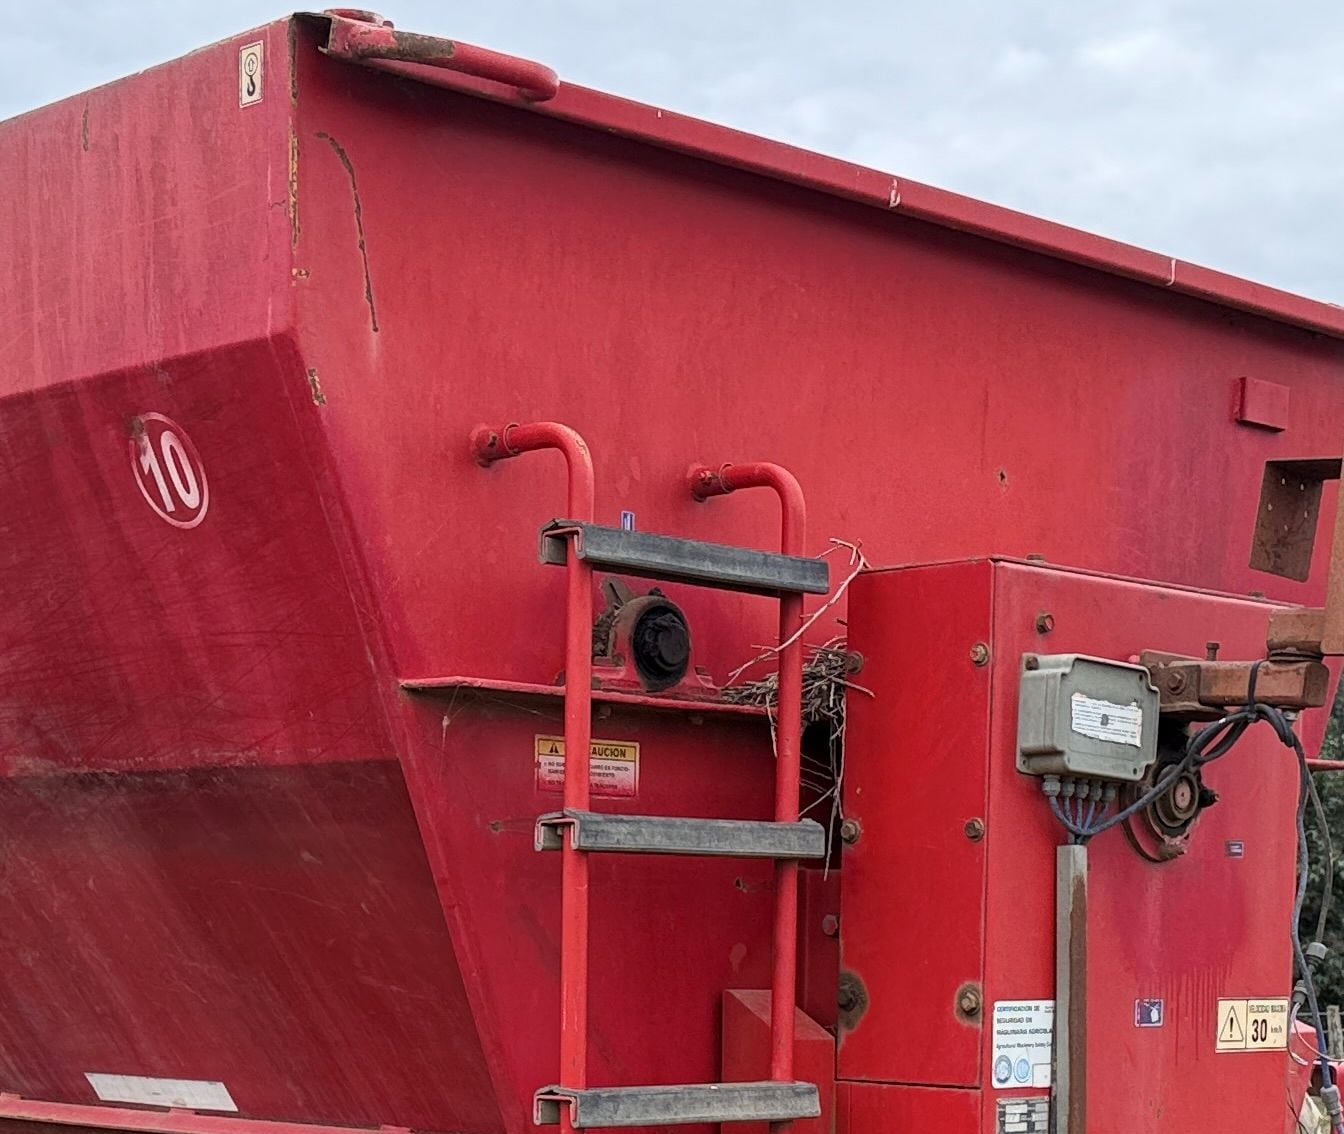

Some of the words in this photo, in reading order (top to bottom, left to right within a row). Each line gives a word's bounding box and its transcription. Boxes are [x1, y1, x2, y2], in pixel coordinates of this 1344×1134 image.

[140, 431, 200, 513] 10
[591, 746, 626, 758] AUCION
[1251, 1018, 1268, 1043] 30
